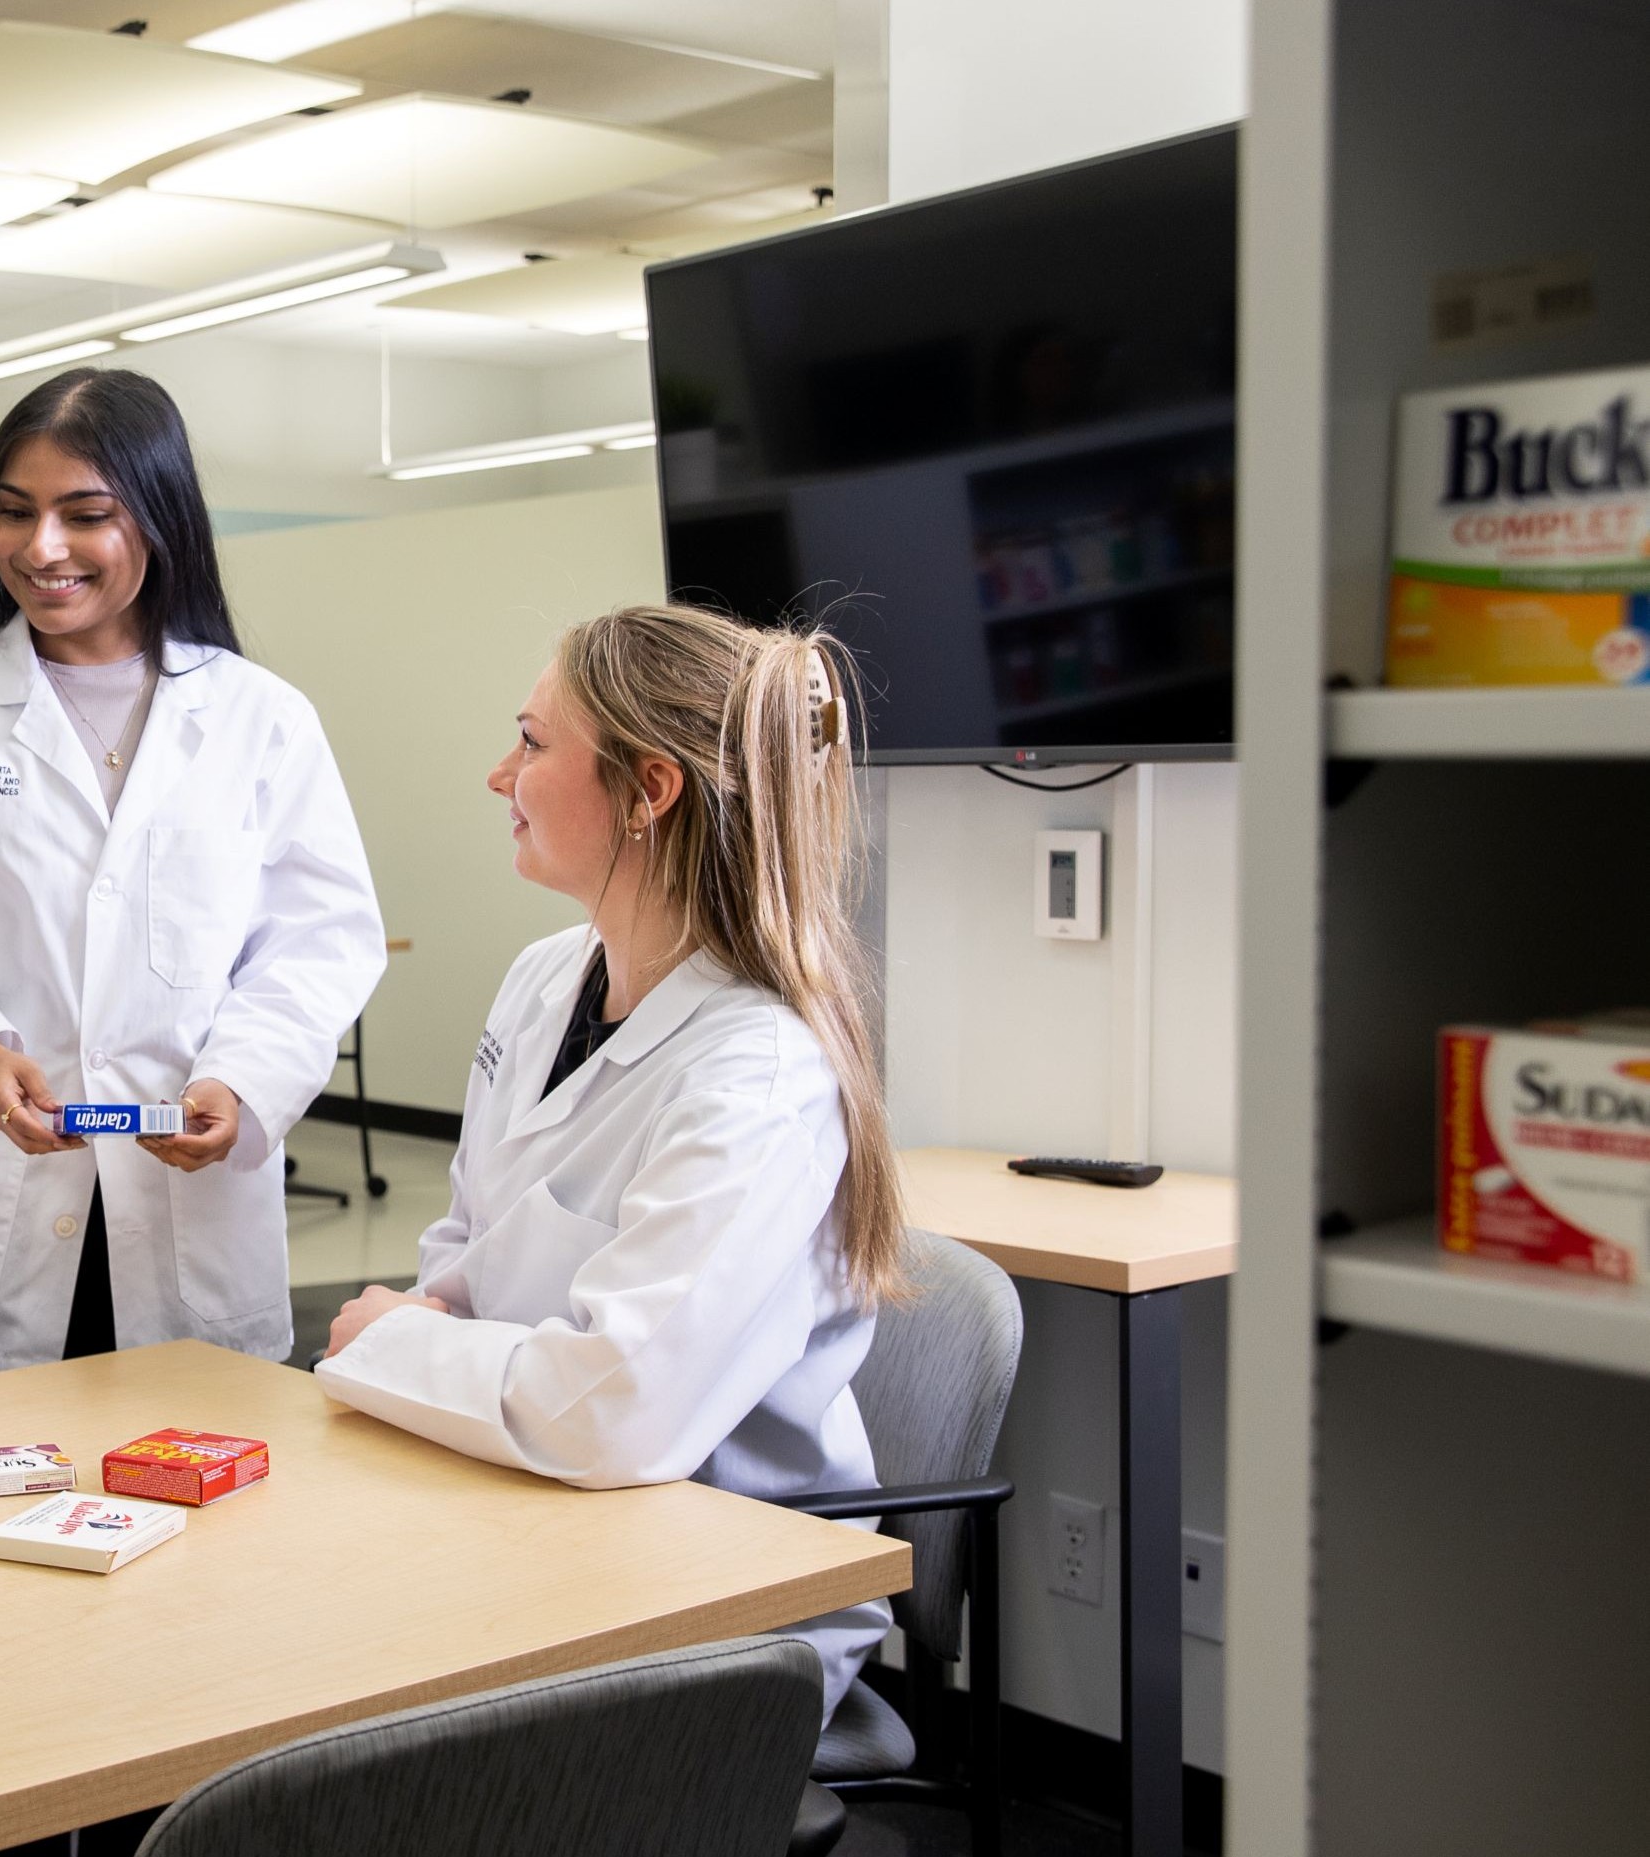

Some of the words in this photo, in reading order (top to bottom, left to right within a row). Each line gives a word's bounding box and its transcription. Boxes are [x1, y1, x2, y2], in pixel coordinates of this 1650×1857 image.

[1025, 752, 1036, 760] LG
[75, 1112, 131, 1130] Claritin
[119, 1444, 217, 1465] Advil
[68, 1501, 104, 1520] Wake
[55, 1519, 84, 1535] Ups
